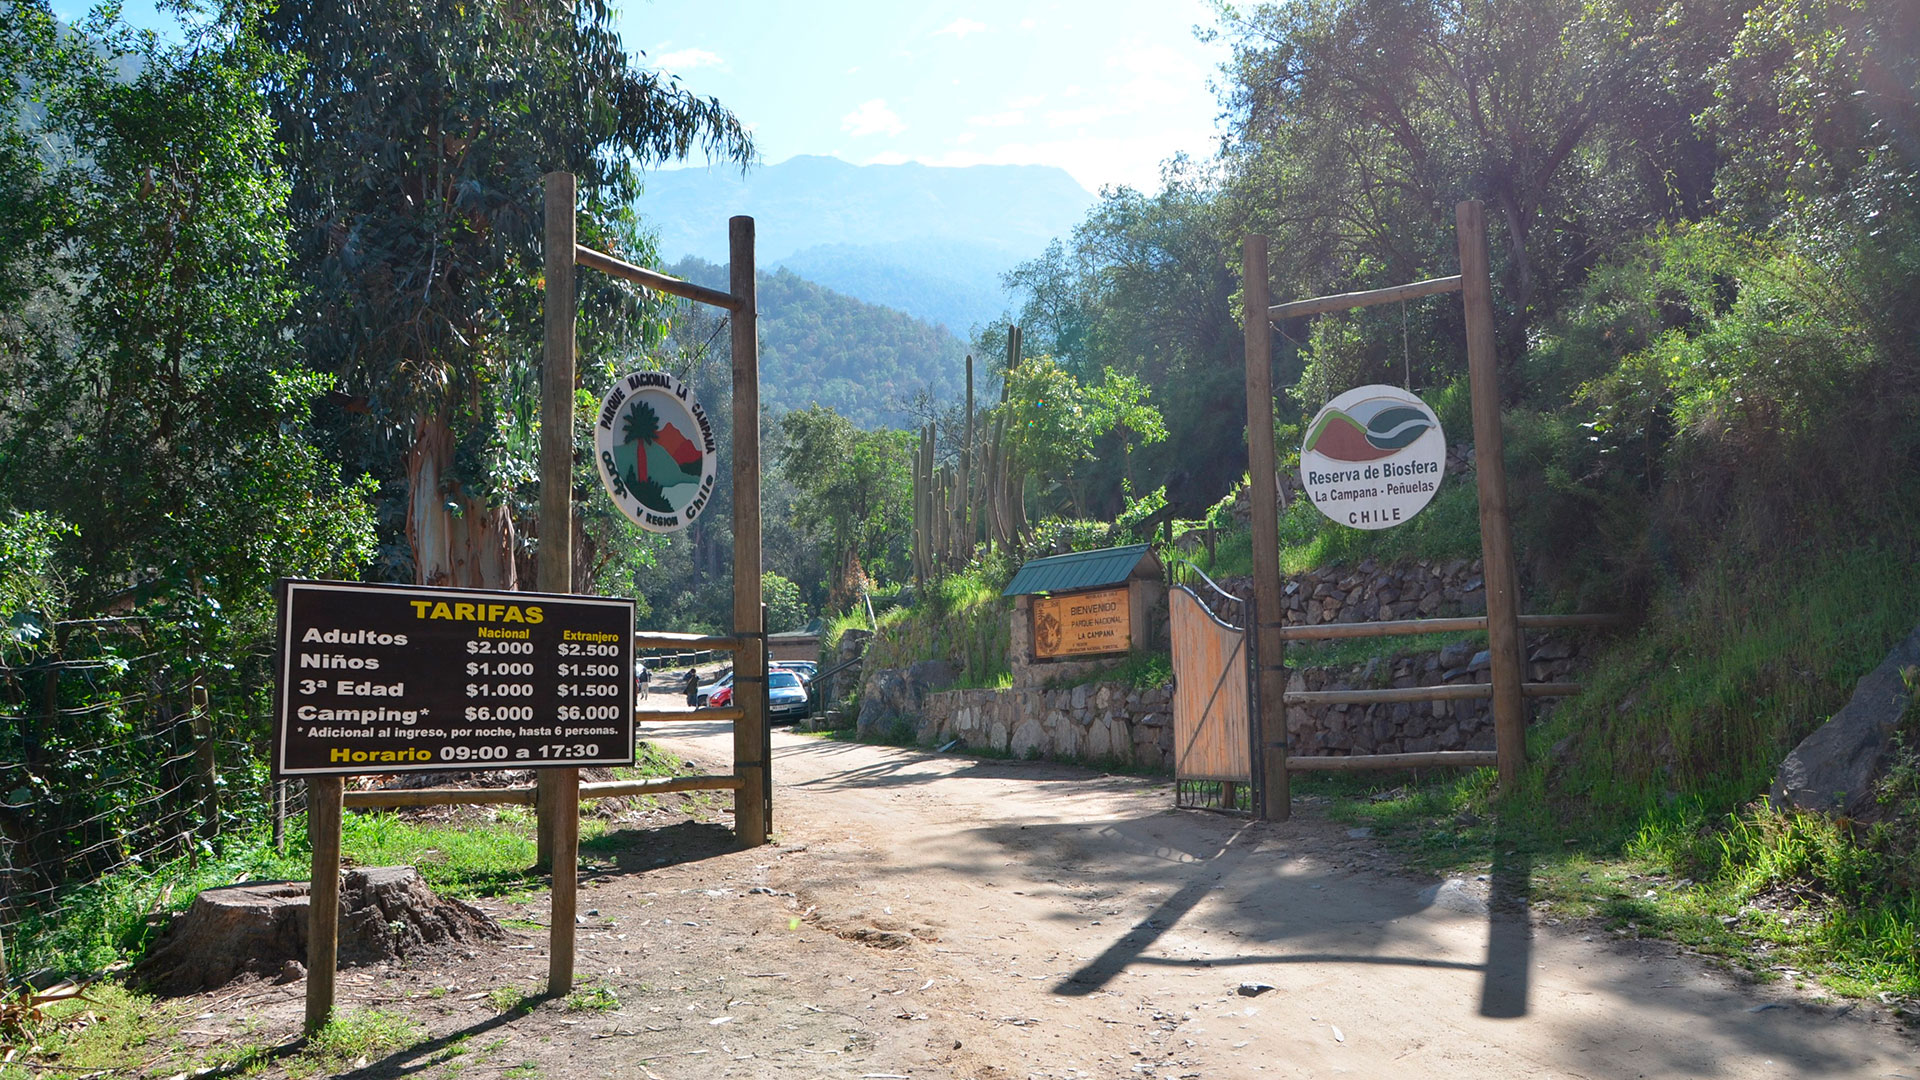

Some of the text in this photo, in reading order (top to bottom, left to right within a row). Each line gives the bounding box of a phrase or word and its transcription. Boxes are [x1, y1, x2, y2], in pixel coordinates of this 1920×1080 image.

[600, 373, 716, 454] PARQUE NACIONAL LA CAMPANA
[1309, 460, 1438, 485] Reserva de Biosfera
[685, 474, 714, 520] Chile
[1315, 491, 1328, 503] La
[1330, 487, 1378, 502] Campana
[1387, 480, 1435, 496] Peñuelas
[636, 506, 679, 526] V REGION
[1349, 508, 1401, 524] CHILE
[410, 601, 544, 624] TARIFAS
[1071, 602, 1116, 615] BIENVENIDO
[1071, 616, 1122, 628] PARQUE NACIONAL
[302, 628, 619, 657] Adultos $2.000 $2.500
[478, 626, 619, 644] Nacional Extranjero
[1078, 630, 1114, 640] LA CAMPANA
[301, 653, 619, 677] Niños $1.000 $1.500
[299, 679, 619, 697] 3ª Edad $1.000 $1.500
[465, 706, 534, 722] $6.000
[557, 705, 620, 722] $6.000
[308, 727, 374, 738] Adicional
[378, 727, 391, 738] al
[395, 727, 447, 740] ingreso,
[451, 728, 472, 739] por
[475, 727, 516, 739] noche,
[519, 727, 551, 737] hasta
[554, 726, 562, 736] 6
[565, 727, 618, 737] personas.
[330, 744, 599, 763] Horario 09:00 a 17:30
